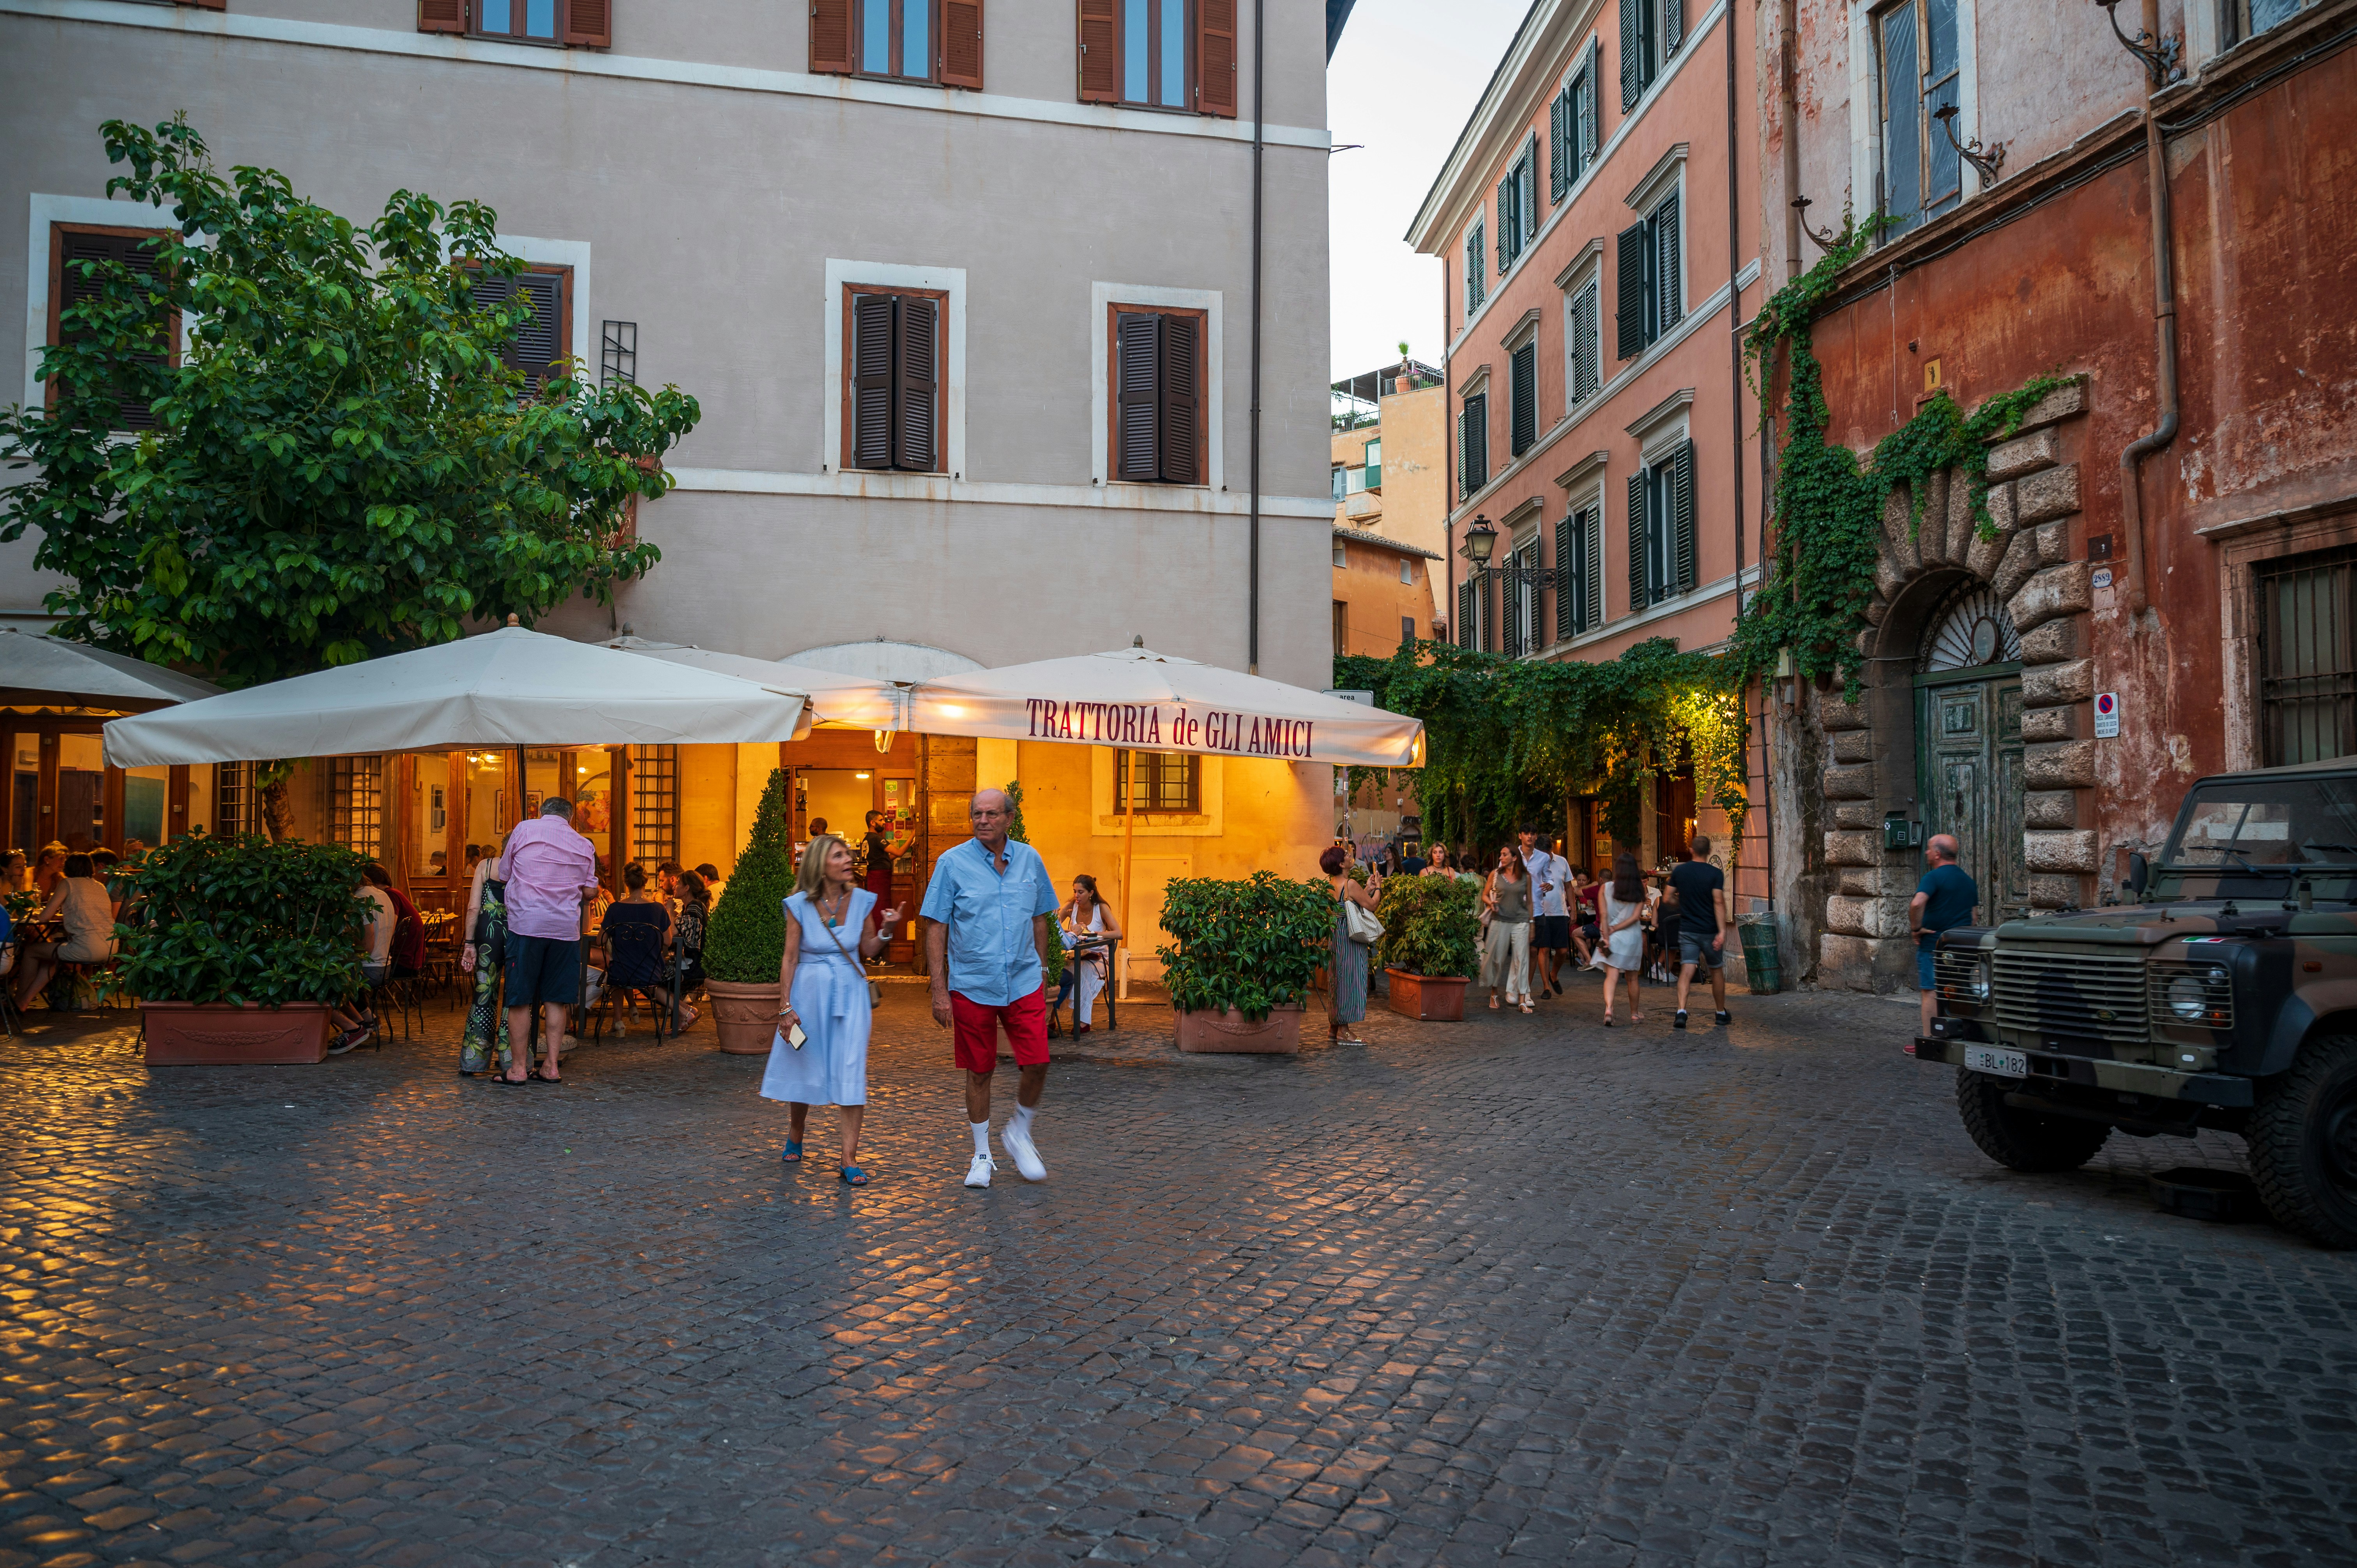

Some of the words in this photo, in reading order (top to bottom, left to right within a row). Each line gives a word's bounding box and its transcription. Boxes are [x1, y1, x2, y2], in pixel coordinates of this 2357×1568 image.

[2094, 573, 2110, 583] 2889
[2101, 590, 2108, 605] 7
[1026, 698, 1162, 743] TRATTORIA
[1173, 708, 1198, 746] de
[1205, 712, 1243, 751] GLI
[1247, 716, 1314, 758] AMICI
[1985, 1052, 1998, 1069] BL
[2006, 1056, 2025, 1074] 182
